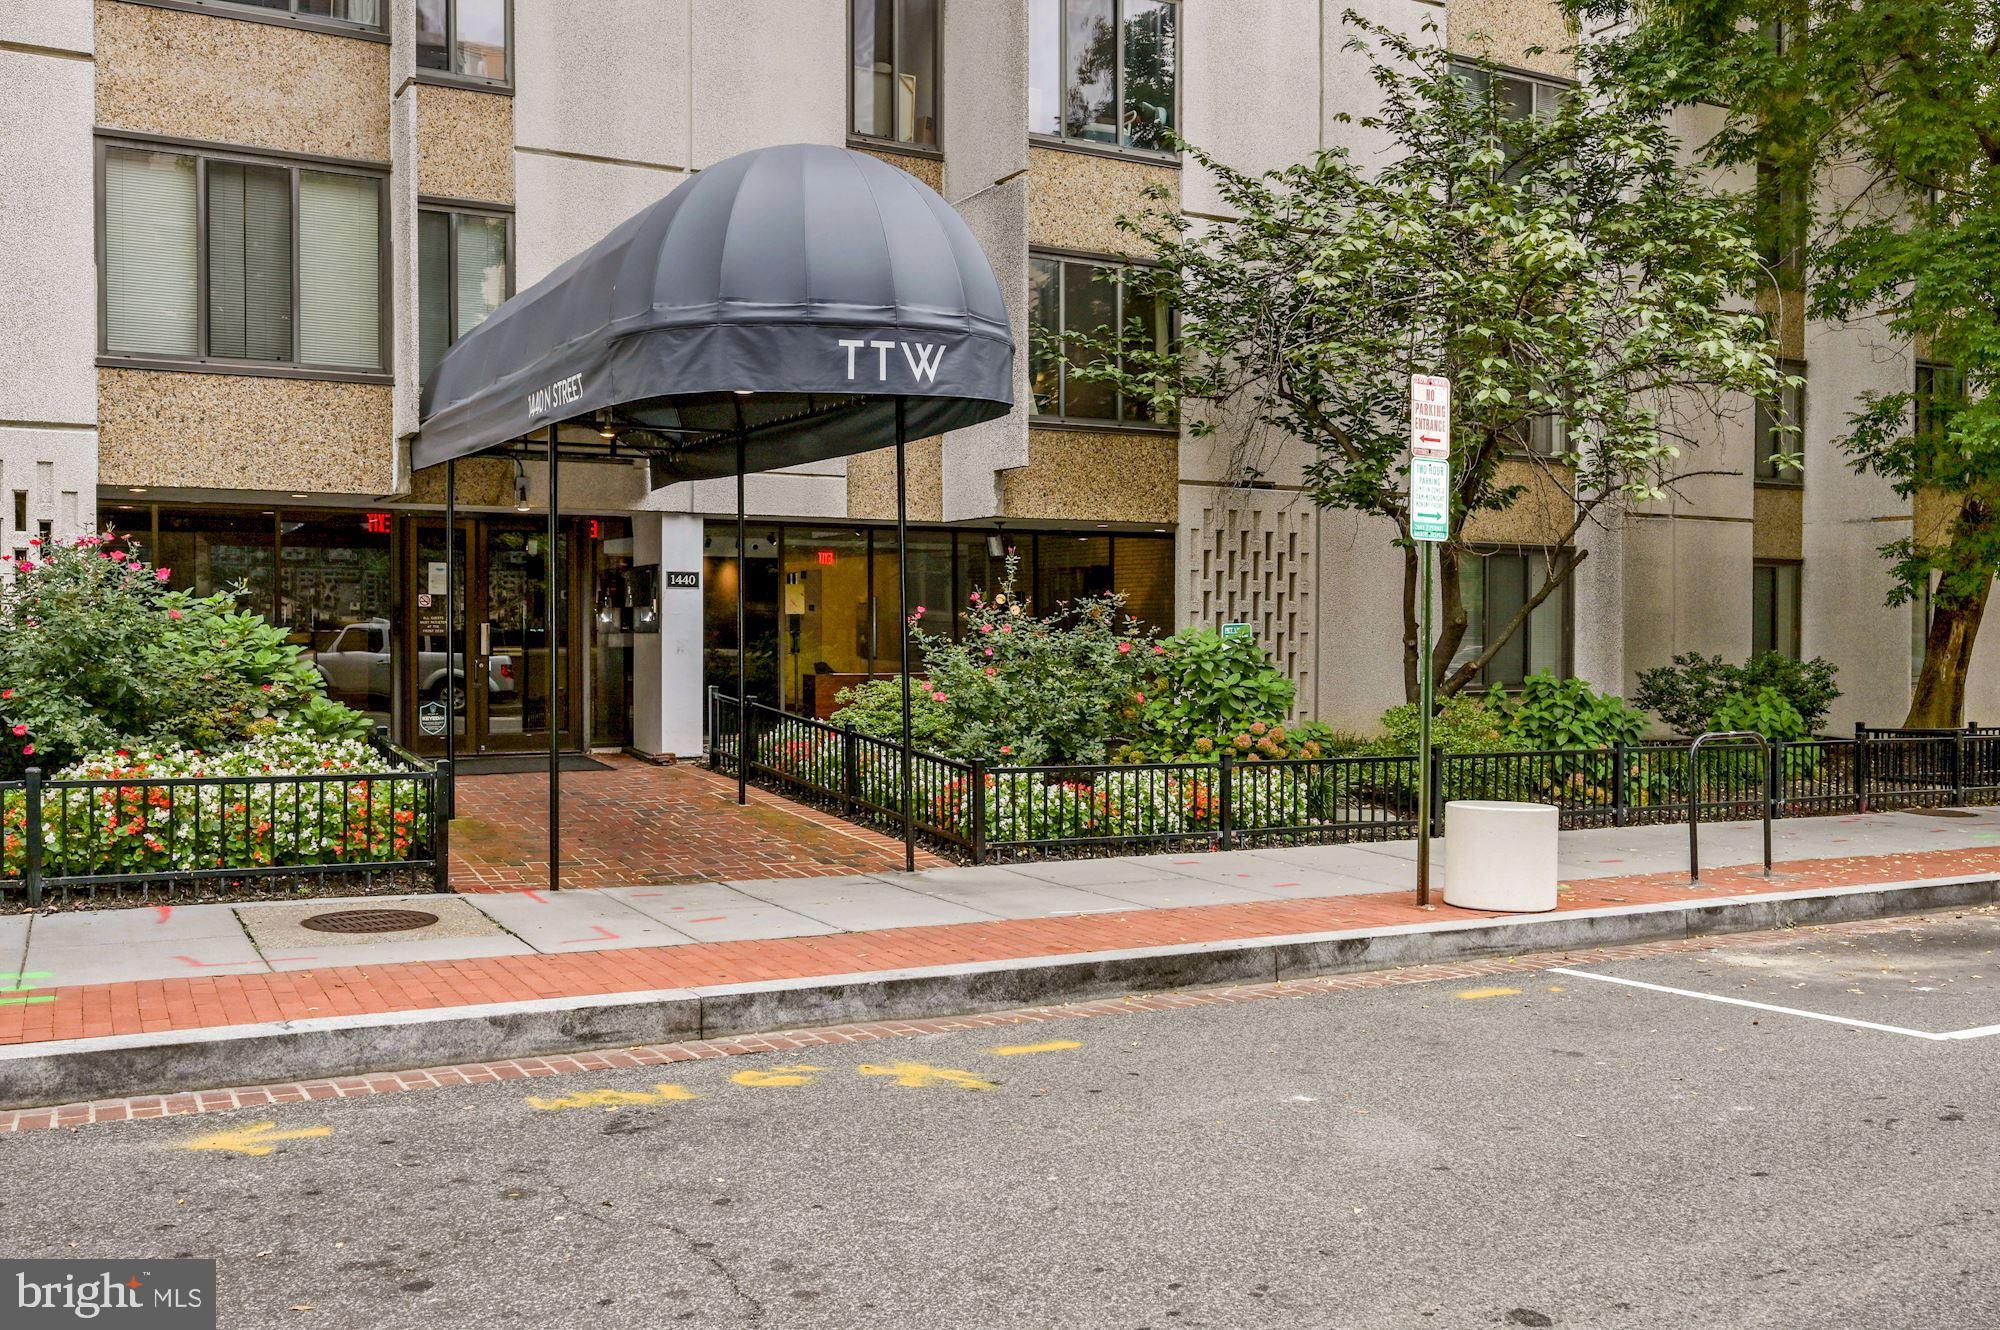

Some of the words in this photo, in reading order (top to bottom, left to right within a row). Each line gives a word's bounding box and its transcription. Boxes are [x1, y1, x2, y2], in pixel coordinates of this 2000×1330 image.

[838, 339, 947, 384] TTW
[552, 372, 583, 408] STREET
[1425, 389, 1435, 402] NO
[1415, 402, 1446, 417] PARKING
[1415, 417, 1446, 432] ENTRANCE
[1417, 464, 1427, 475] TWO
[1428, 466, 1444, 476] HOUR
[1419, 476, 1441, 486] PARKING
[670, 574, 696, 586] 1440
